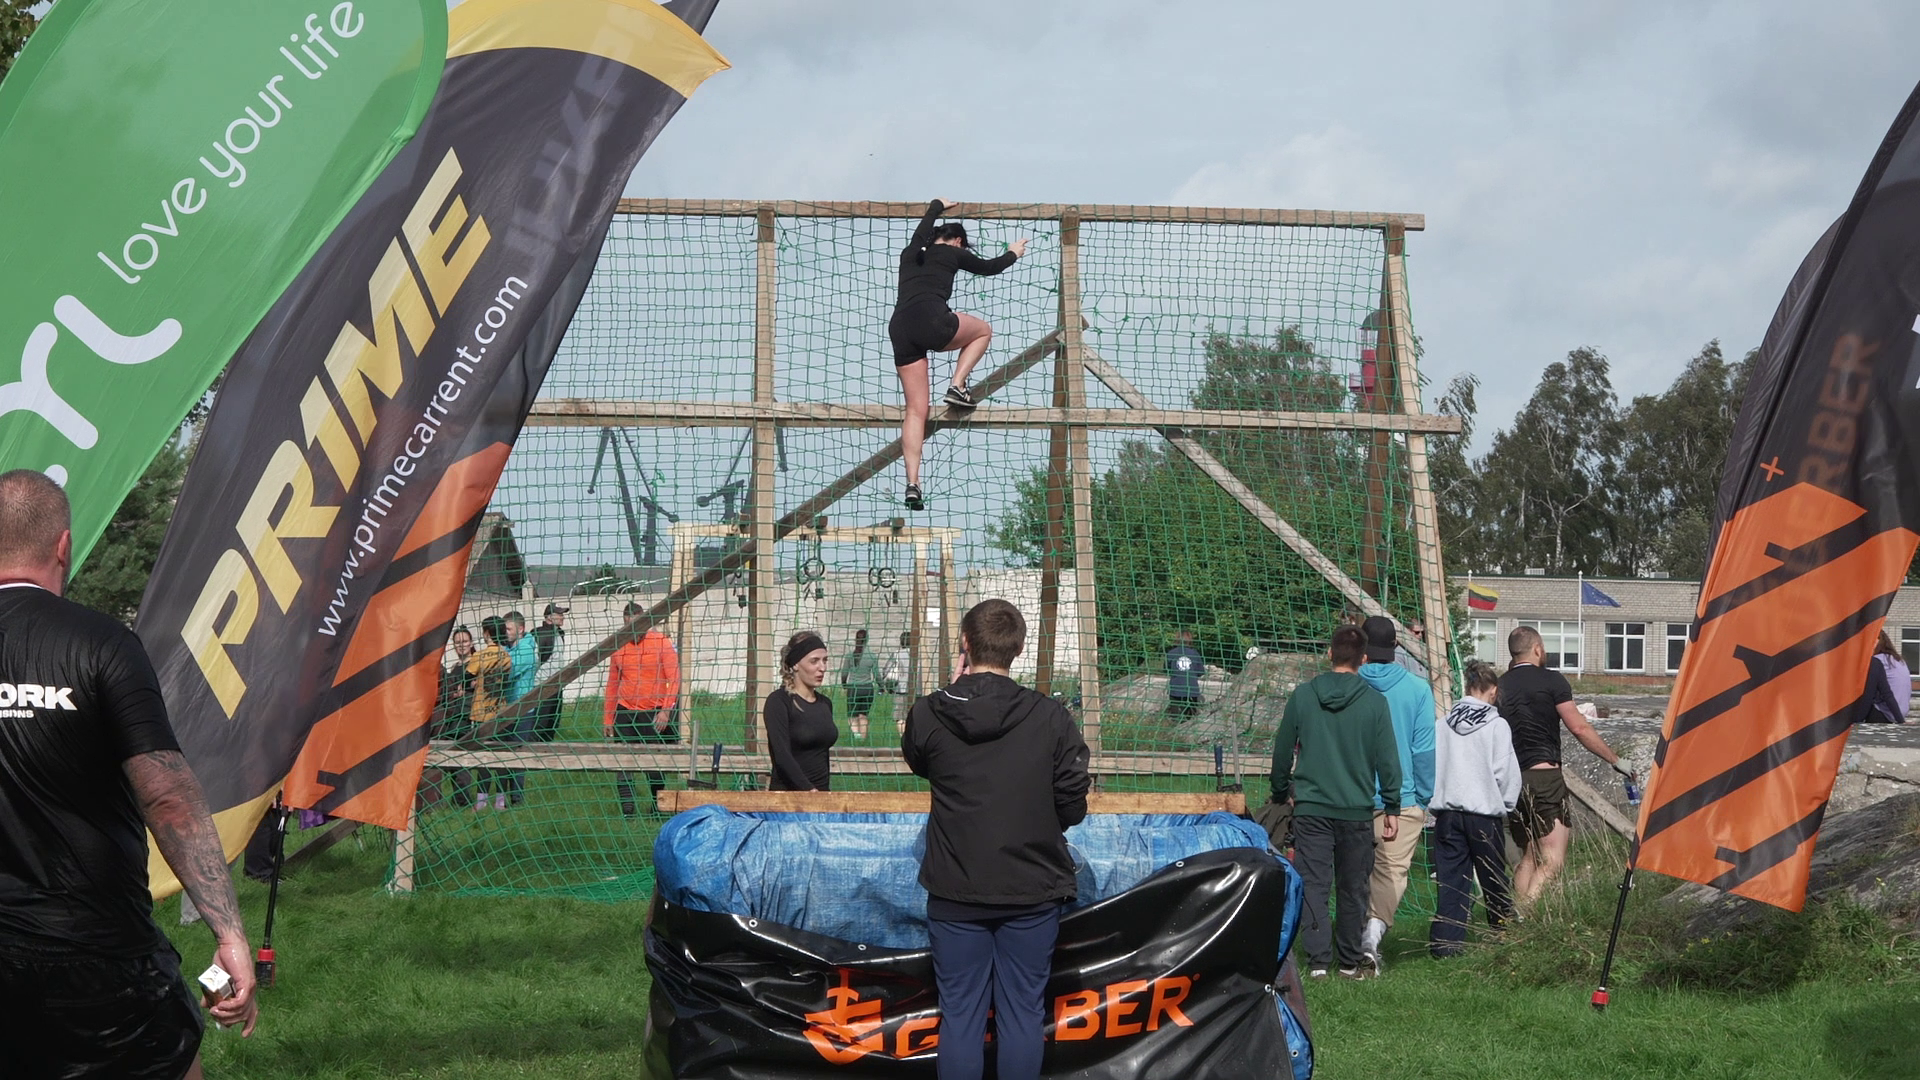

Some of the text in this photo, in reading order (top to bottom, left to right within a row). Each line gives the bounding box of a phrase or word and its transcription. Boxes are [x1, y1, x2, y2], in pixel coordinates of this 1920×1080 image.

[97, 1, 364, 284] love your life
[0, 295, 182, 488] YL
[318, 274, 528, 636] www.primecarrent.com
[894, 977, 1193, 1058] GBER
